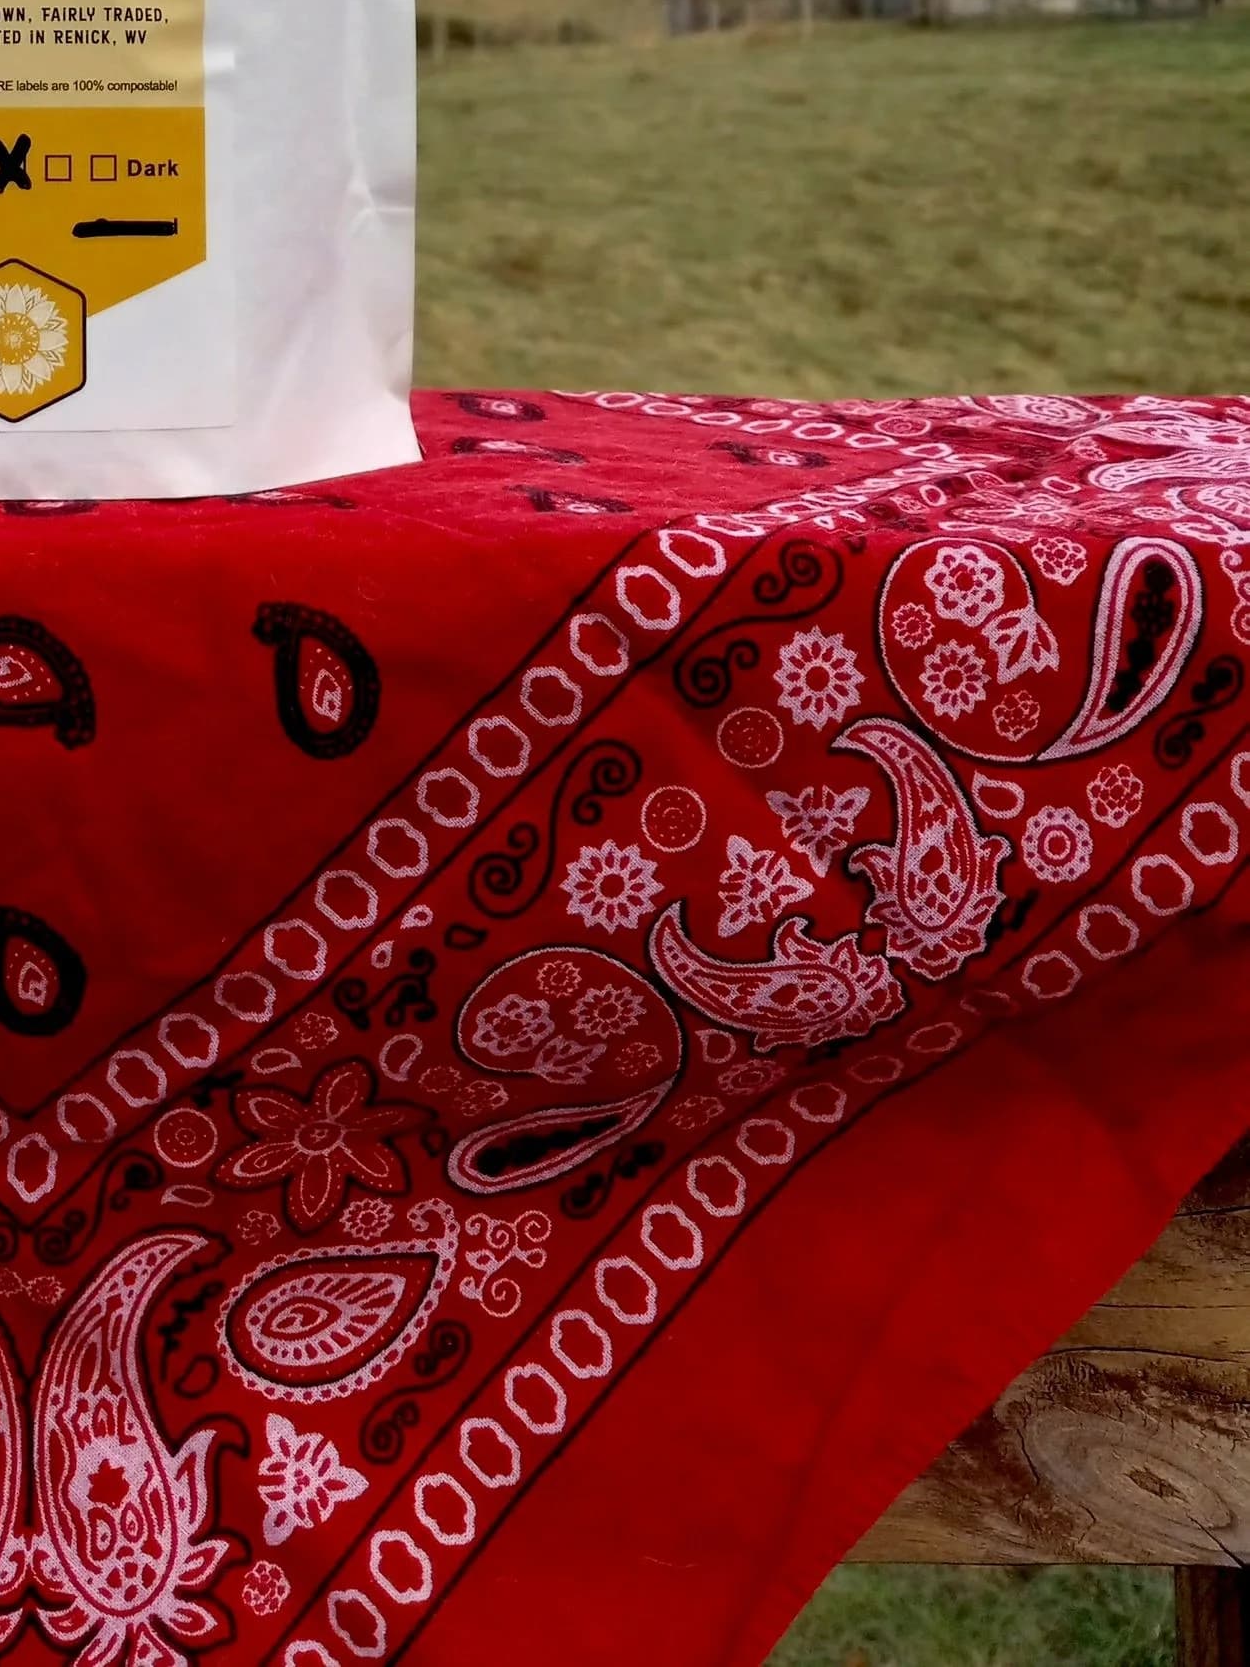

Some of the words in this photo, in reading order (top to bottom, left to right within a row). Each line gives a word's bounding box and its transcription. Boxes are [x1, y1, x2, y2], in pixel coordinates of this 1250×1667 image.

[41, 7, 96, 22] FAIRLY
[103, 7, 169, 24] TRADED,
[29, 30, 45, 44] IN
[53, 30, 117, 46] RENICK,
[125, 30, 147, 45] WV
[16, 80, 48, 92] labels
[51, 82, 70, 91] are
[73, 81, 105, 91] 100%
[107, 81, 178, 94] compostable!
[127, 159, 179, 177] Dark
